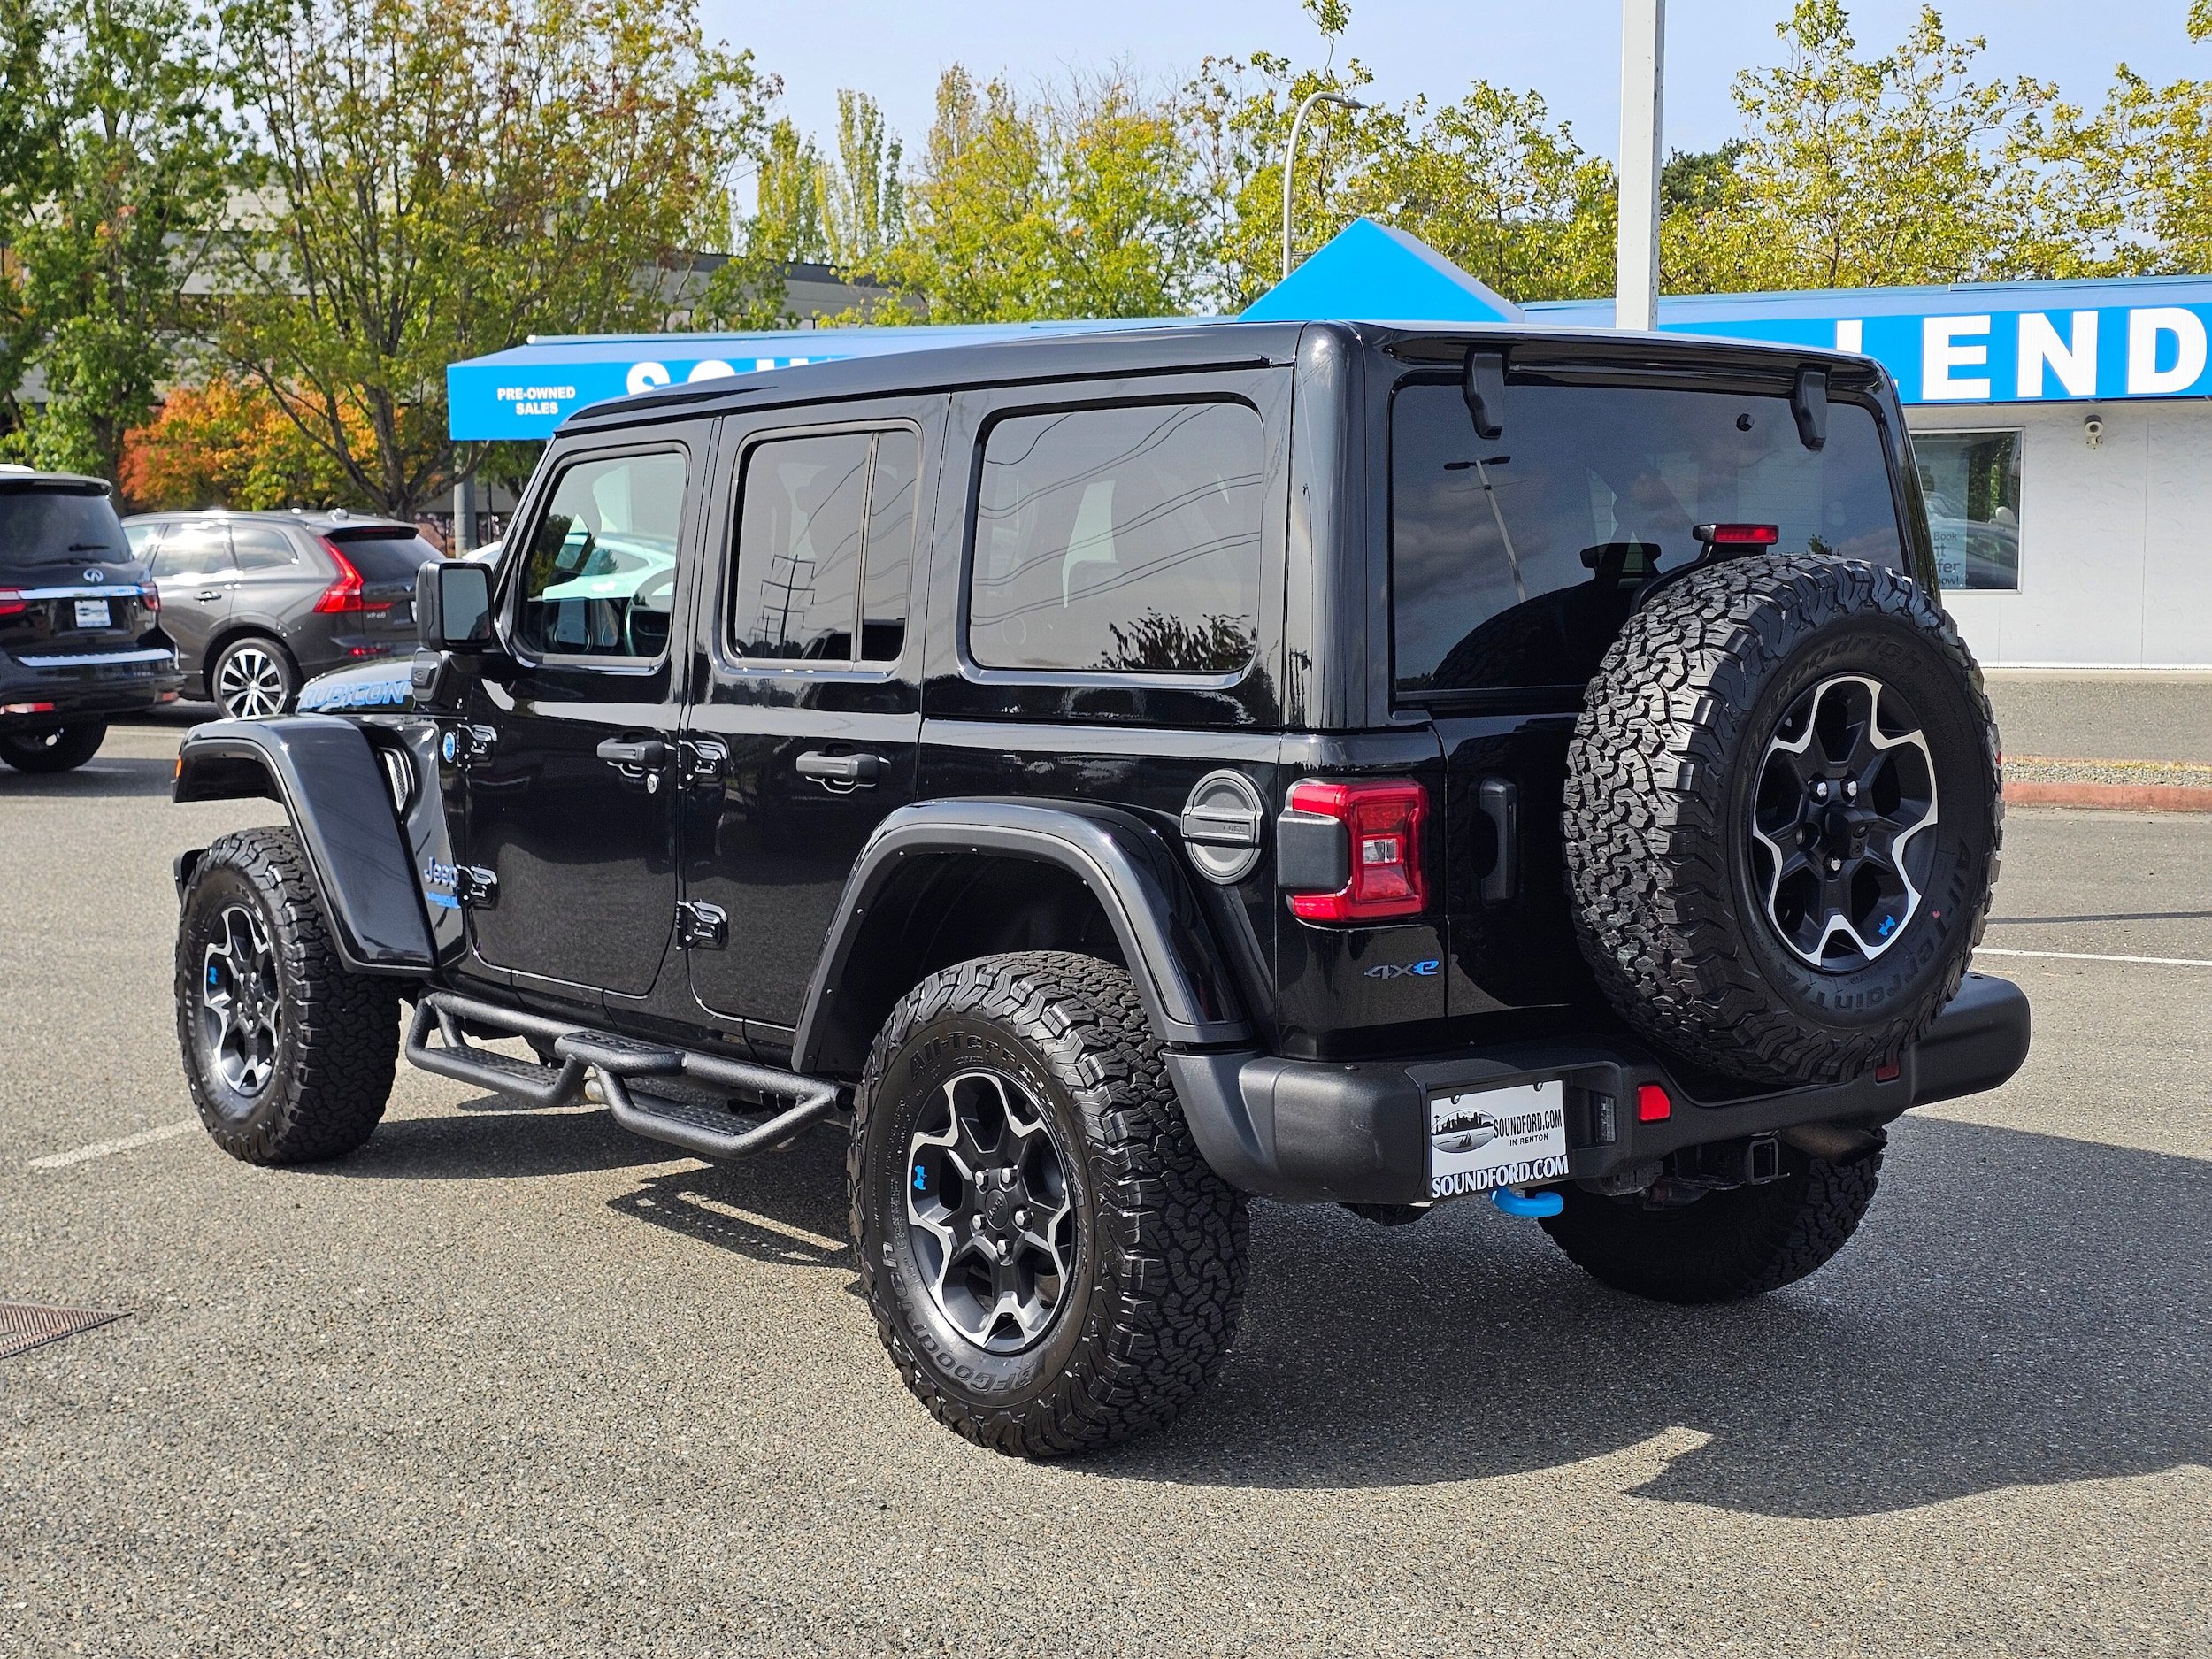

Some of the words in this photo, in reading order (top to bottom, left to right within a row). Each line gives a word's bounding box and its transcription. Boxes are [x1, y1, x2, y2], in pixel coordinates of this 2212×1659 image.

[497, 386, 576, 401] PRE-OWNED
[515, 401, 558, 415] SALES
[1933, 531, 1958, 541] Book
[1936, 558, 1961, 573] fer
[298, 679, 411, 708] RUBICON
[424, 856, 458, 888] Jeep
[1493, 1108, 1563, 1139] SOUNDFORD.COM
[1519, 1133, 1548, 1146] RENTON
[1431, 1155, 1570, 1199] SOUNDFORD.COM
[882, 1241, 1036, 1394] BFGoodrich
